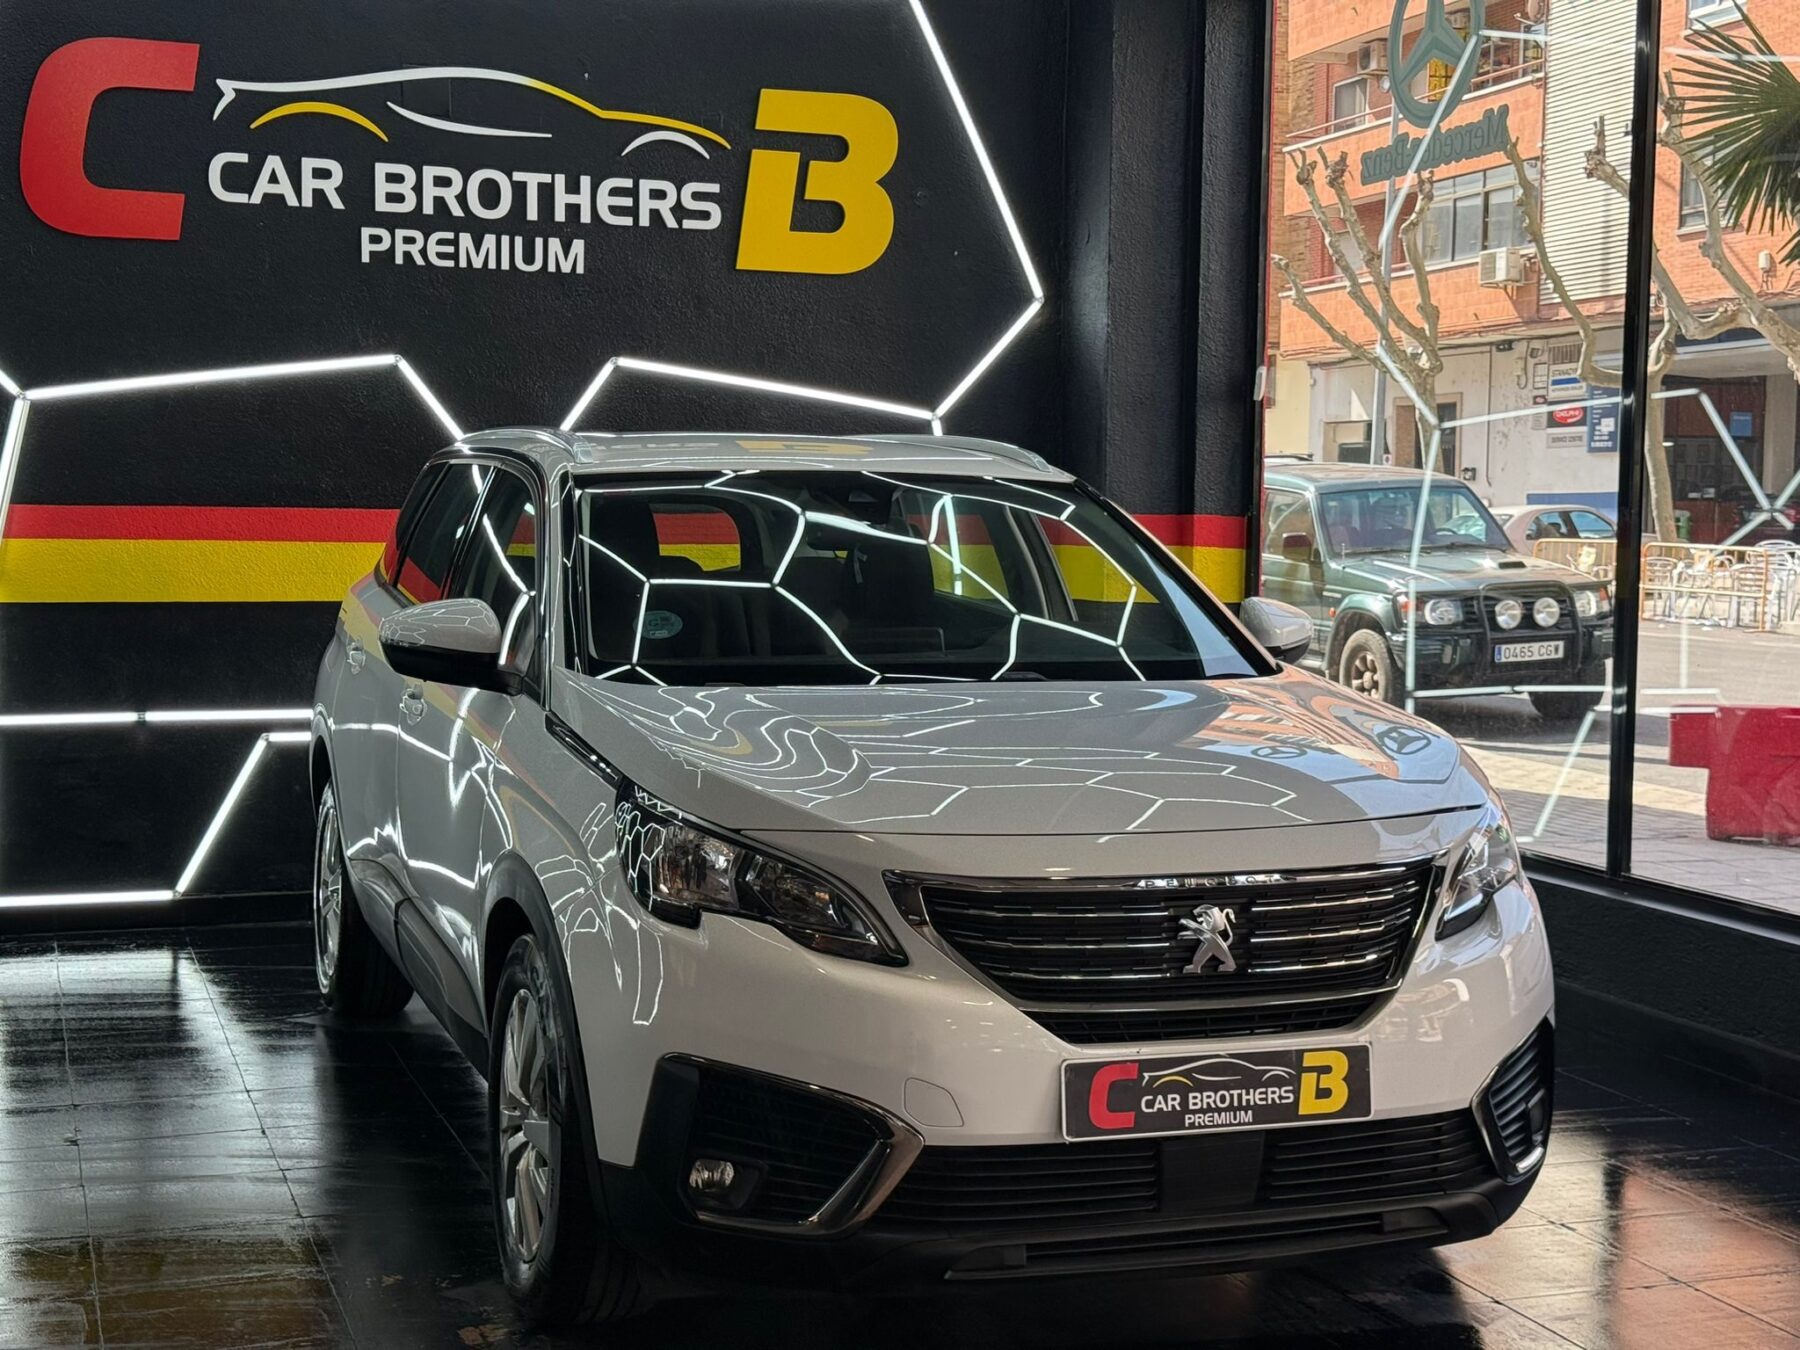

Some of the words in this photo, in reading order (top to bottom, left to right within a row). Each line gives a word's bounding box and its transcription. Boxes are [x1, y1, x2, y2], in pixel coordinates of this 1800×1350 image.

[20, 37, 199, 241] C
[208, 152, 344, 209] CAR
[375, 162, 722, 230] BROTHERS
[736, 88, 900, 274] B
[361, 226, 585, 275] PREMIUM
[1503, 645, 1534, 660] 0465
[1088, 1062, 1139, 1129] C
[1140, 1093, 1181, 1113] CAR
[1188, 1086, 1294, 1110] BROTHERS
[1298, 1050, 1349, 1115] B
[1184, 1110, 1253, 1127] PREMIUM
